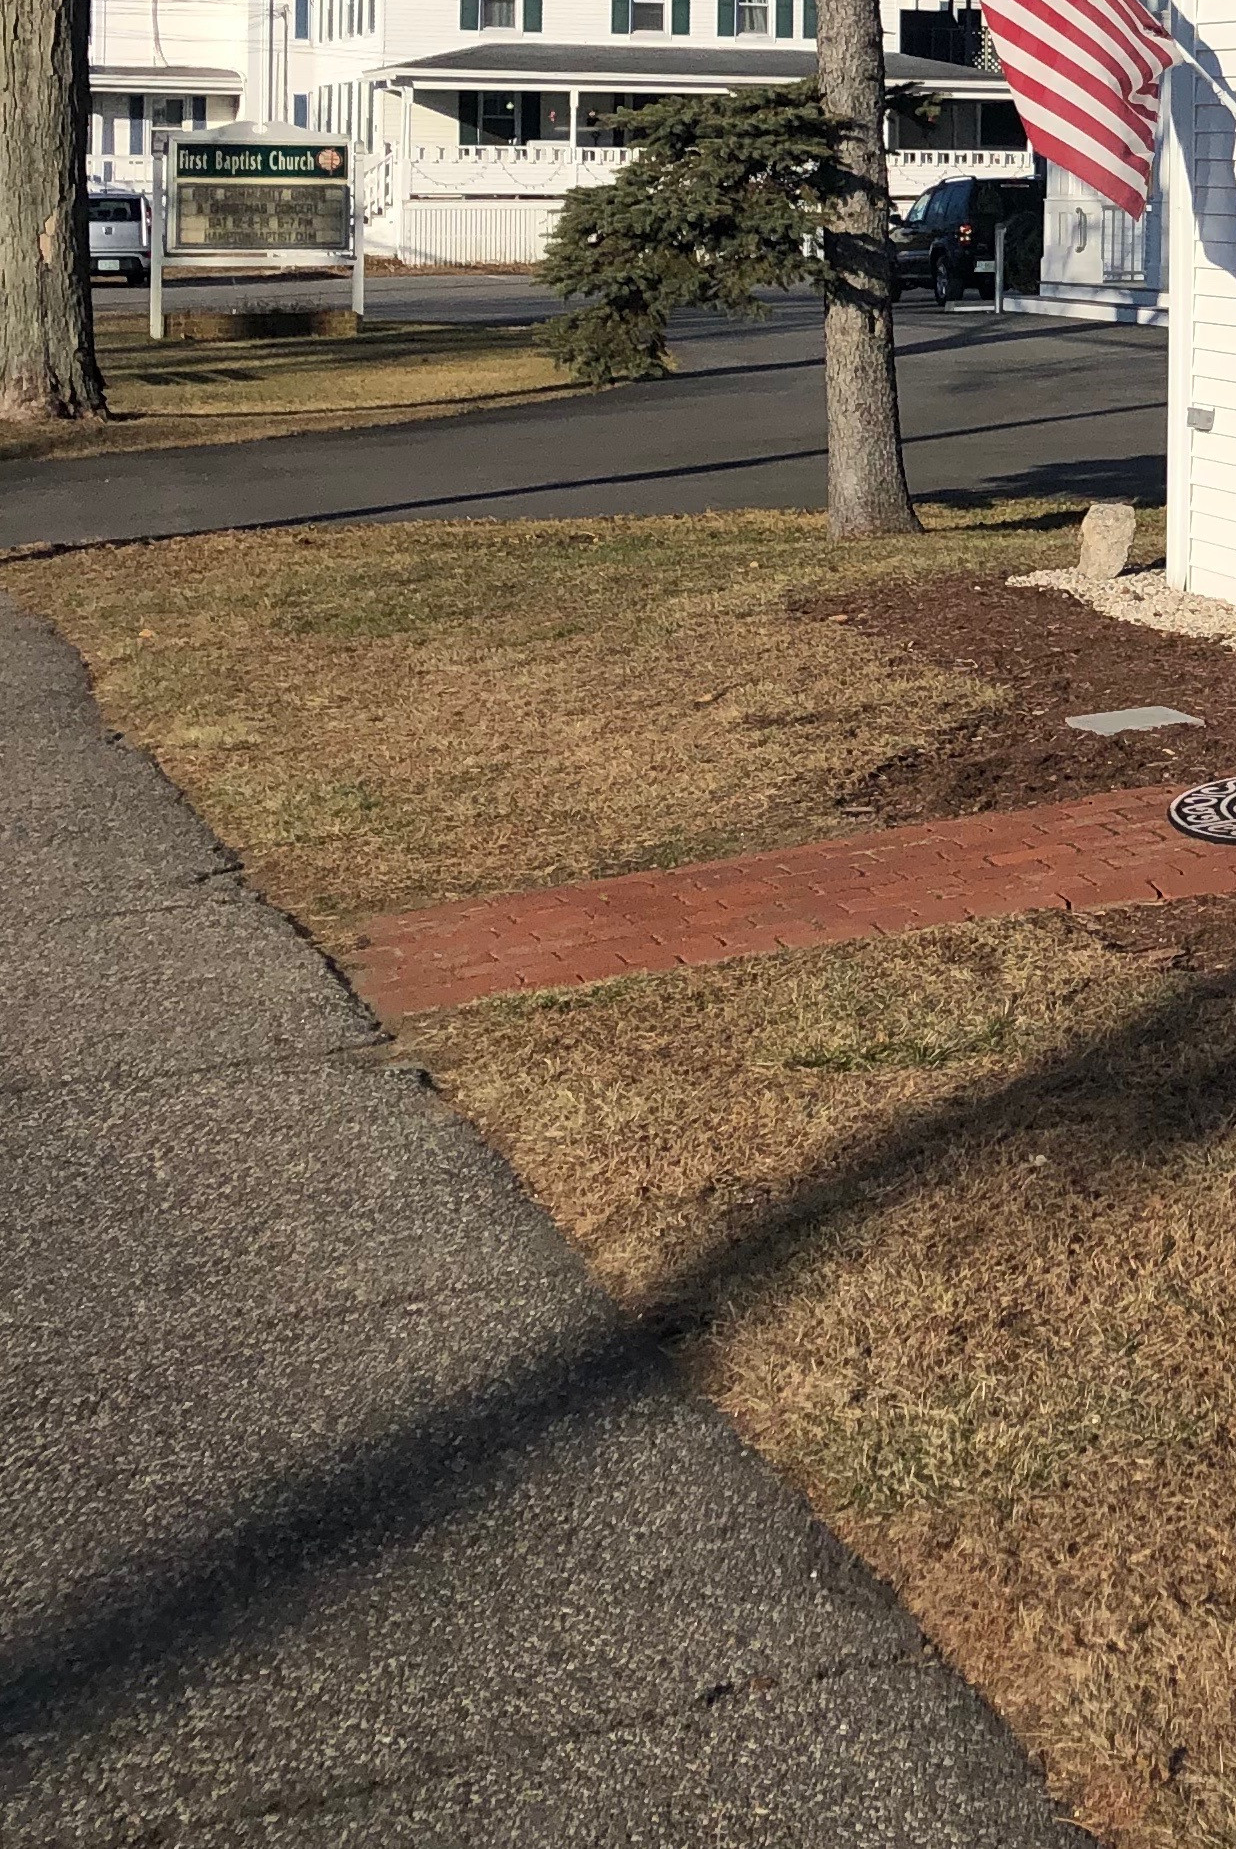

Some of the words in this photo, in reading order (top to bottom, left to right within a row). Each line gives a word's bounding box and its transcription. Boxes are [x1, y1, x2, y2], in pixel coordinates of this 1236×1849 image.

[179, 149, 208, 170] First
[215, 150, 264, 175] Baptist
[268, 150, 315, 171] Church
